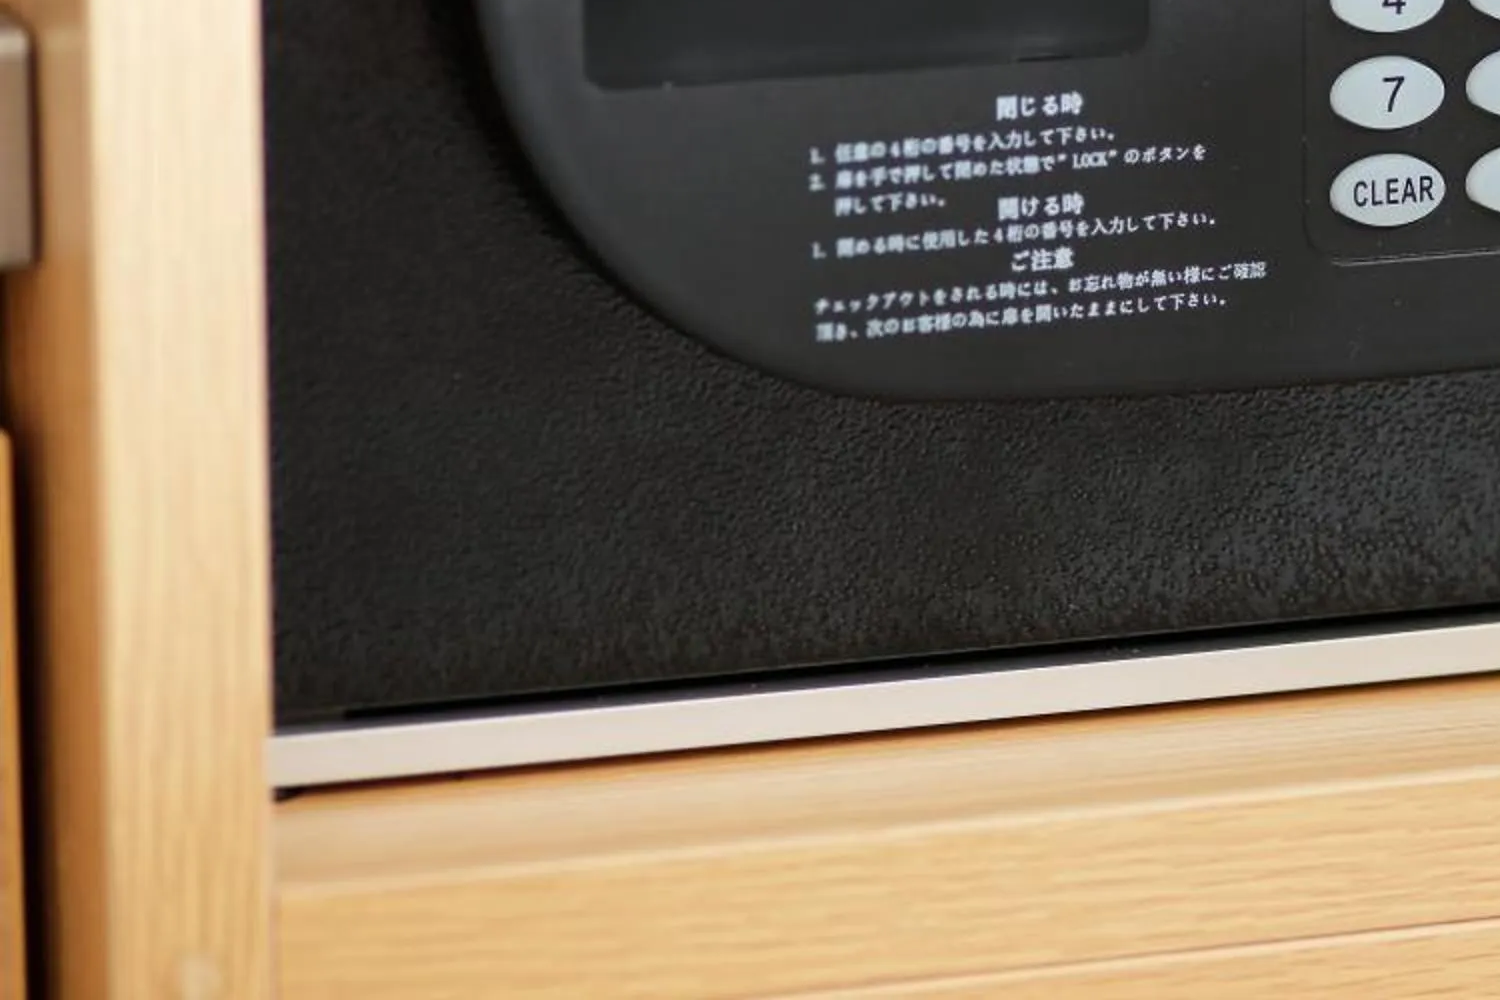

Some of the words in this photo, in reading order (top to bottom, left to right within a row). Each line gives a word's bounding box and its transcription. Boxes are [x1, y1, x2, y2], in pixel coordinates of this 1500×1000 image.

[1382, 76, 1405, 112] 7
[1353, 175, 1434, 207] CLEAR
[1011, 247, 1074, 272] ご注意
